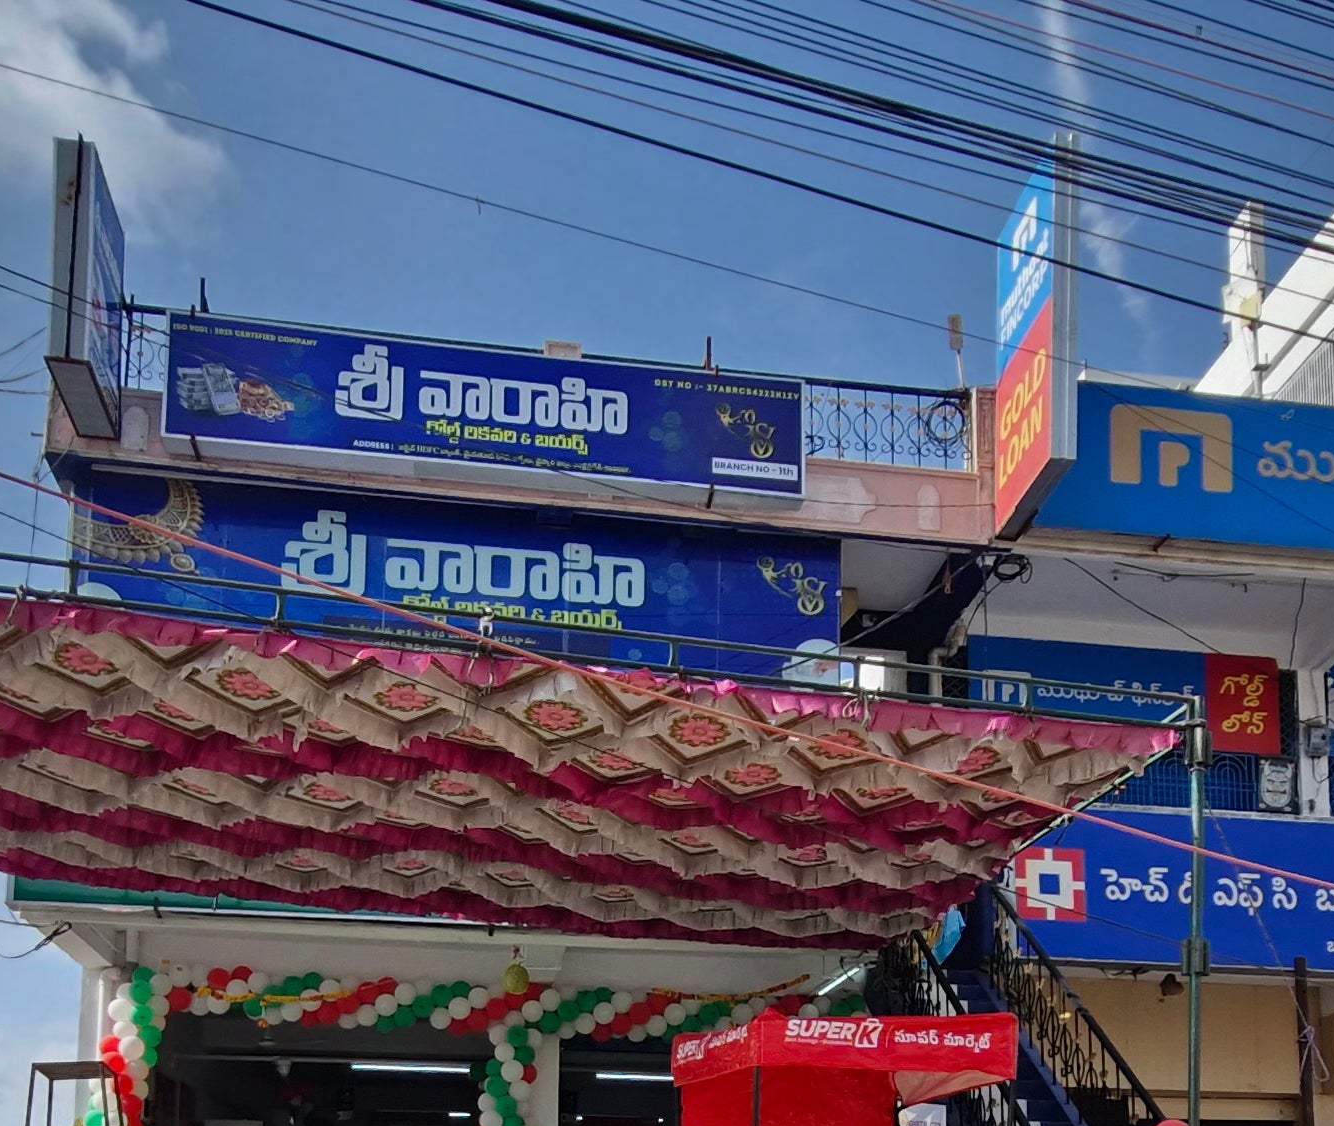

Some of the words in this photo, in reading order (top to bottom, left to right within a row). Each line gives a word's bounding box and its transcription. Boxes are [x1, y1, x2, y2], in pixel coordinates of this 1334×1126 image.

[1000, 261, 1049, 351] FINCORP
[234, 329, 276, 341] CERTIFIED
[277, 335, 318, 347] COMPANY
[334, 344, 405, 422] శ్రీ
[418, 369, 629, 435] వారాహి
[999, 348, 1046, 441] GOLD
[520, 432, 532, 445] &
[998, 393, 1044, 490] LOAN
[714, 461, 754, 473] BRANCH
[756, 464, 770, 474] NO
[280, 510, 367, 597] శ్రీ
[384, 538, 646, 607] వారాహి
[1220, 674, 1269, 708] గోల్డ్
[1222, 711, 1268, 735] లోన్
[1100, 867, 1169, 904] హెచ్
[1213, 873, 1264, 917] ఎఫ్
[1272, 876, 1298, 911] సి
[894, 1029, 939, 1046] సూపర్
